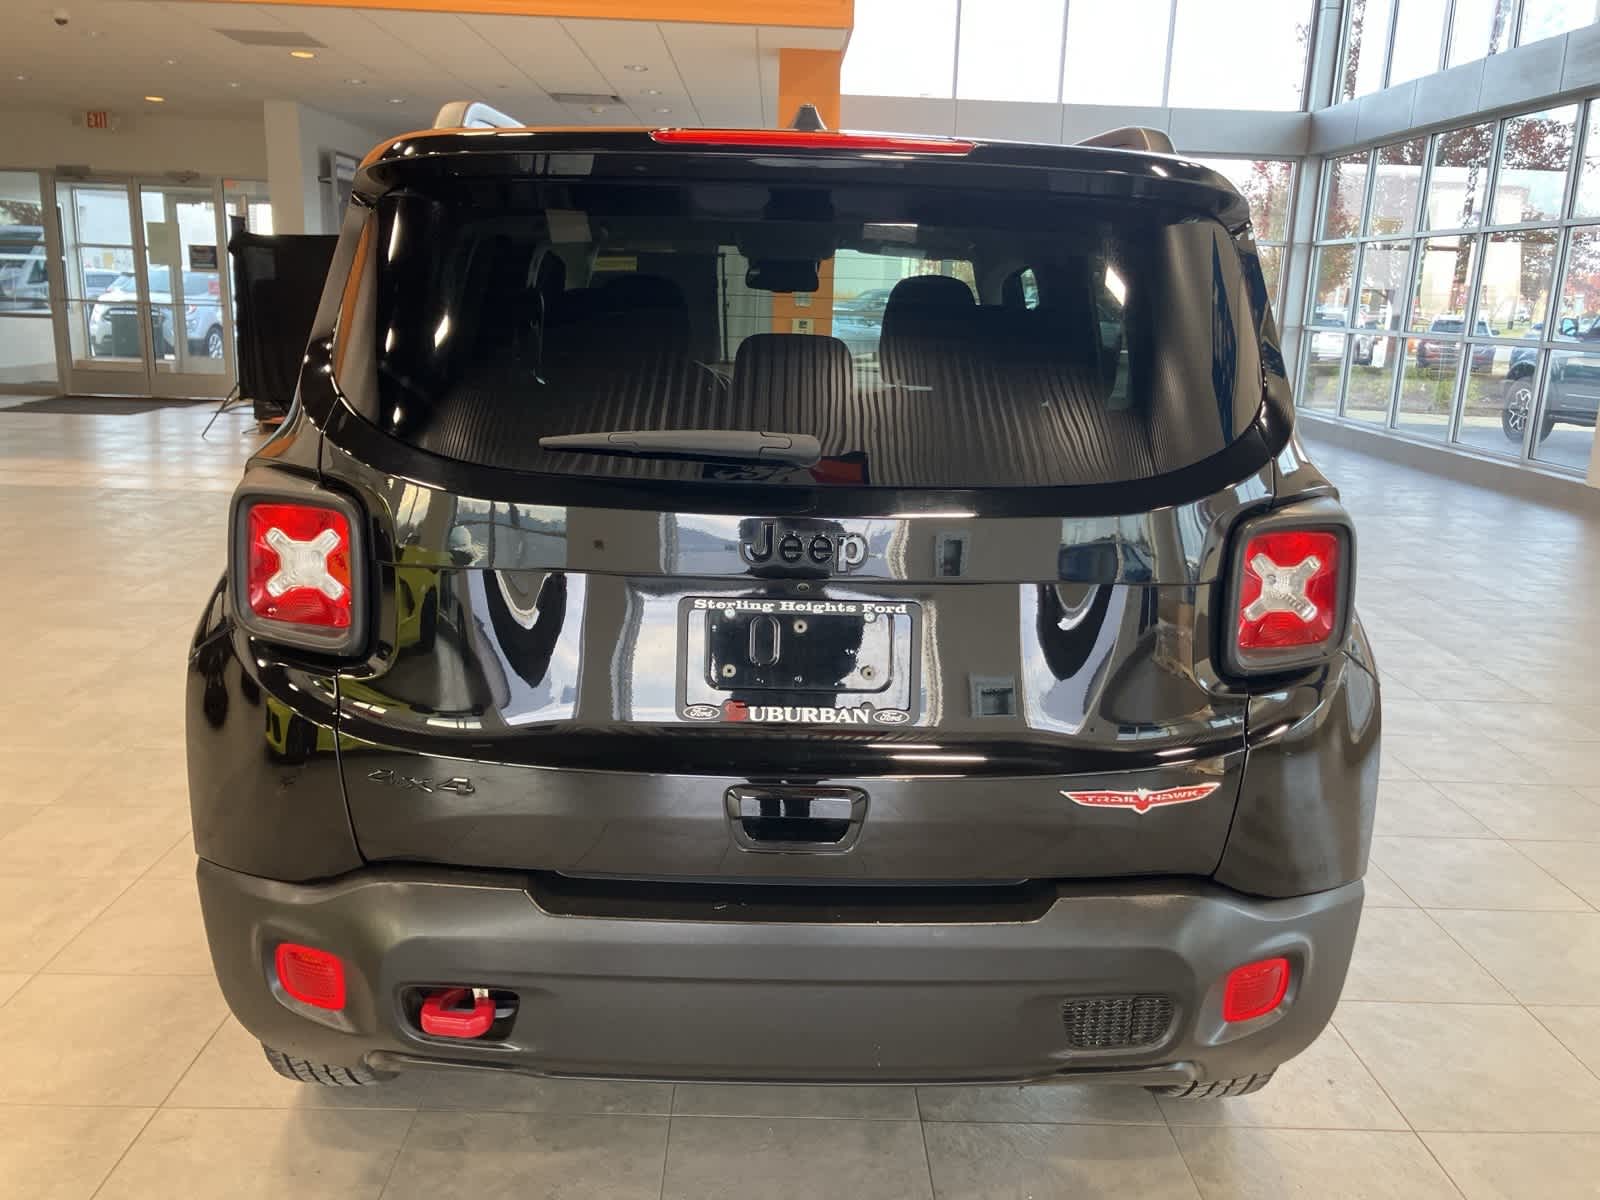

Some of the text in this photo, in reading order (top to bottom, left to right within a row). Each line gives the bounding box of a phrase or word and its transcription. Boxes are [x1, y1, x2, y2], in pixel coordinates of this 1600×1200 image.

[87, 111, 107, 128] EXIT
[739, 519, 868, 574] Jeep
[694, 599, 907, 614] Sterling Heights Ford
